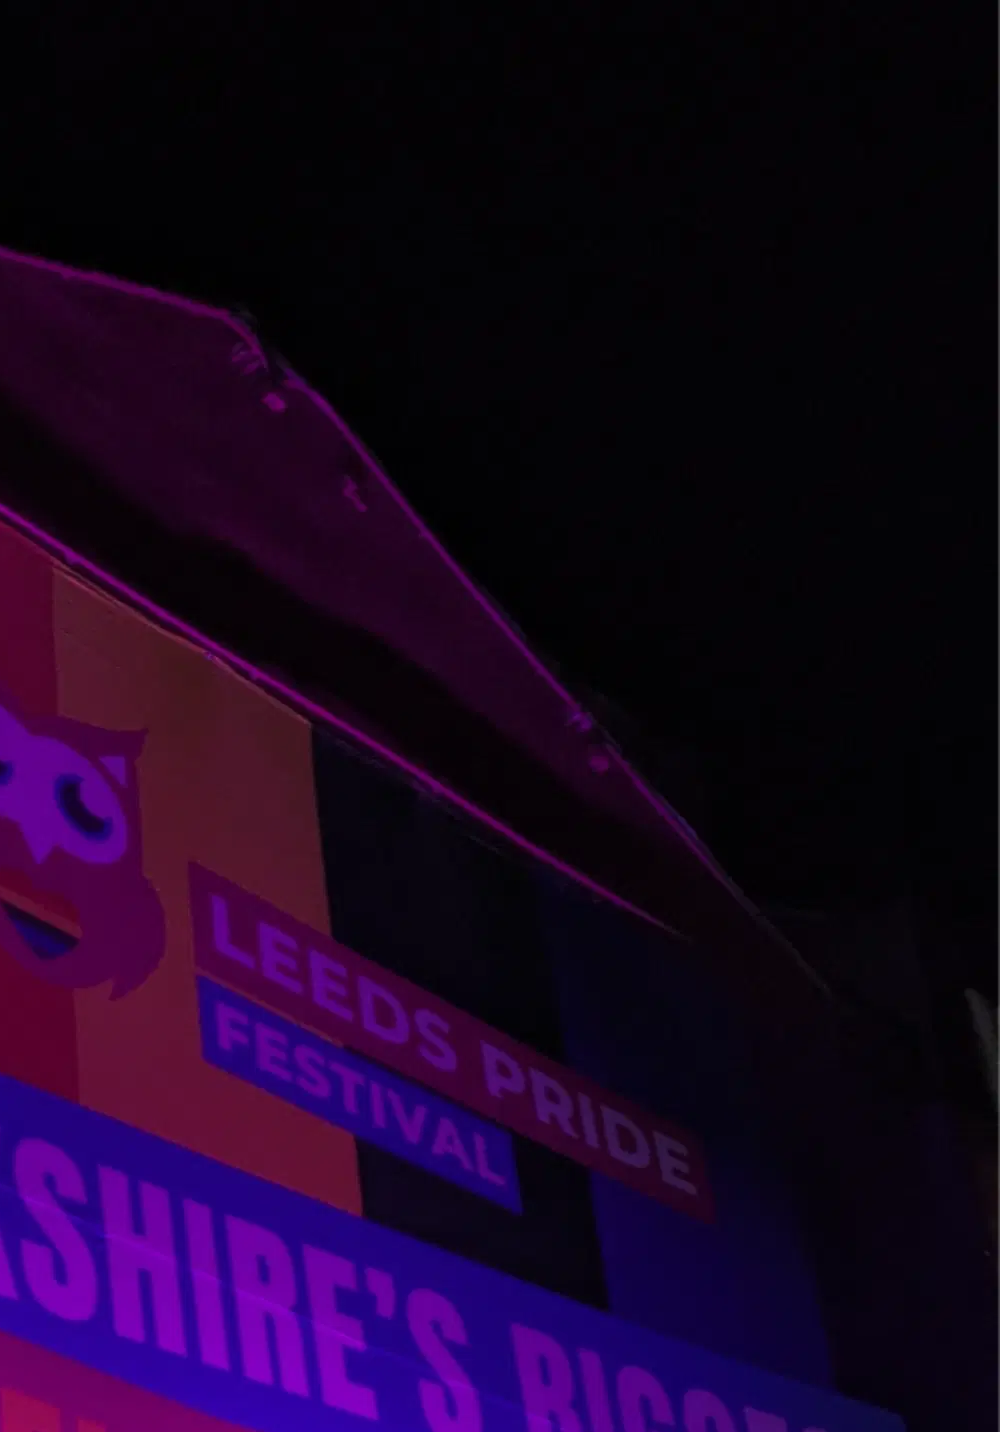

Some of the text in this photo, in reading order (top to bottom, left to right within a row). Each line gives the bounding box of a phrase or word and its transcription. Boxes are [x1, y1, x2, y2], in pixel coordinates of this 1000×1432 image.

[212, 893, 697, 1196] LEEDS PRIDE
[216, 1002, 507, 1185] FESTIVAL
